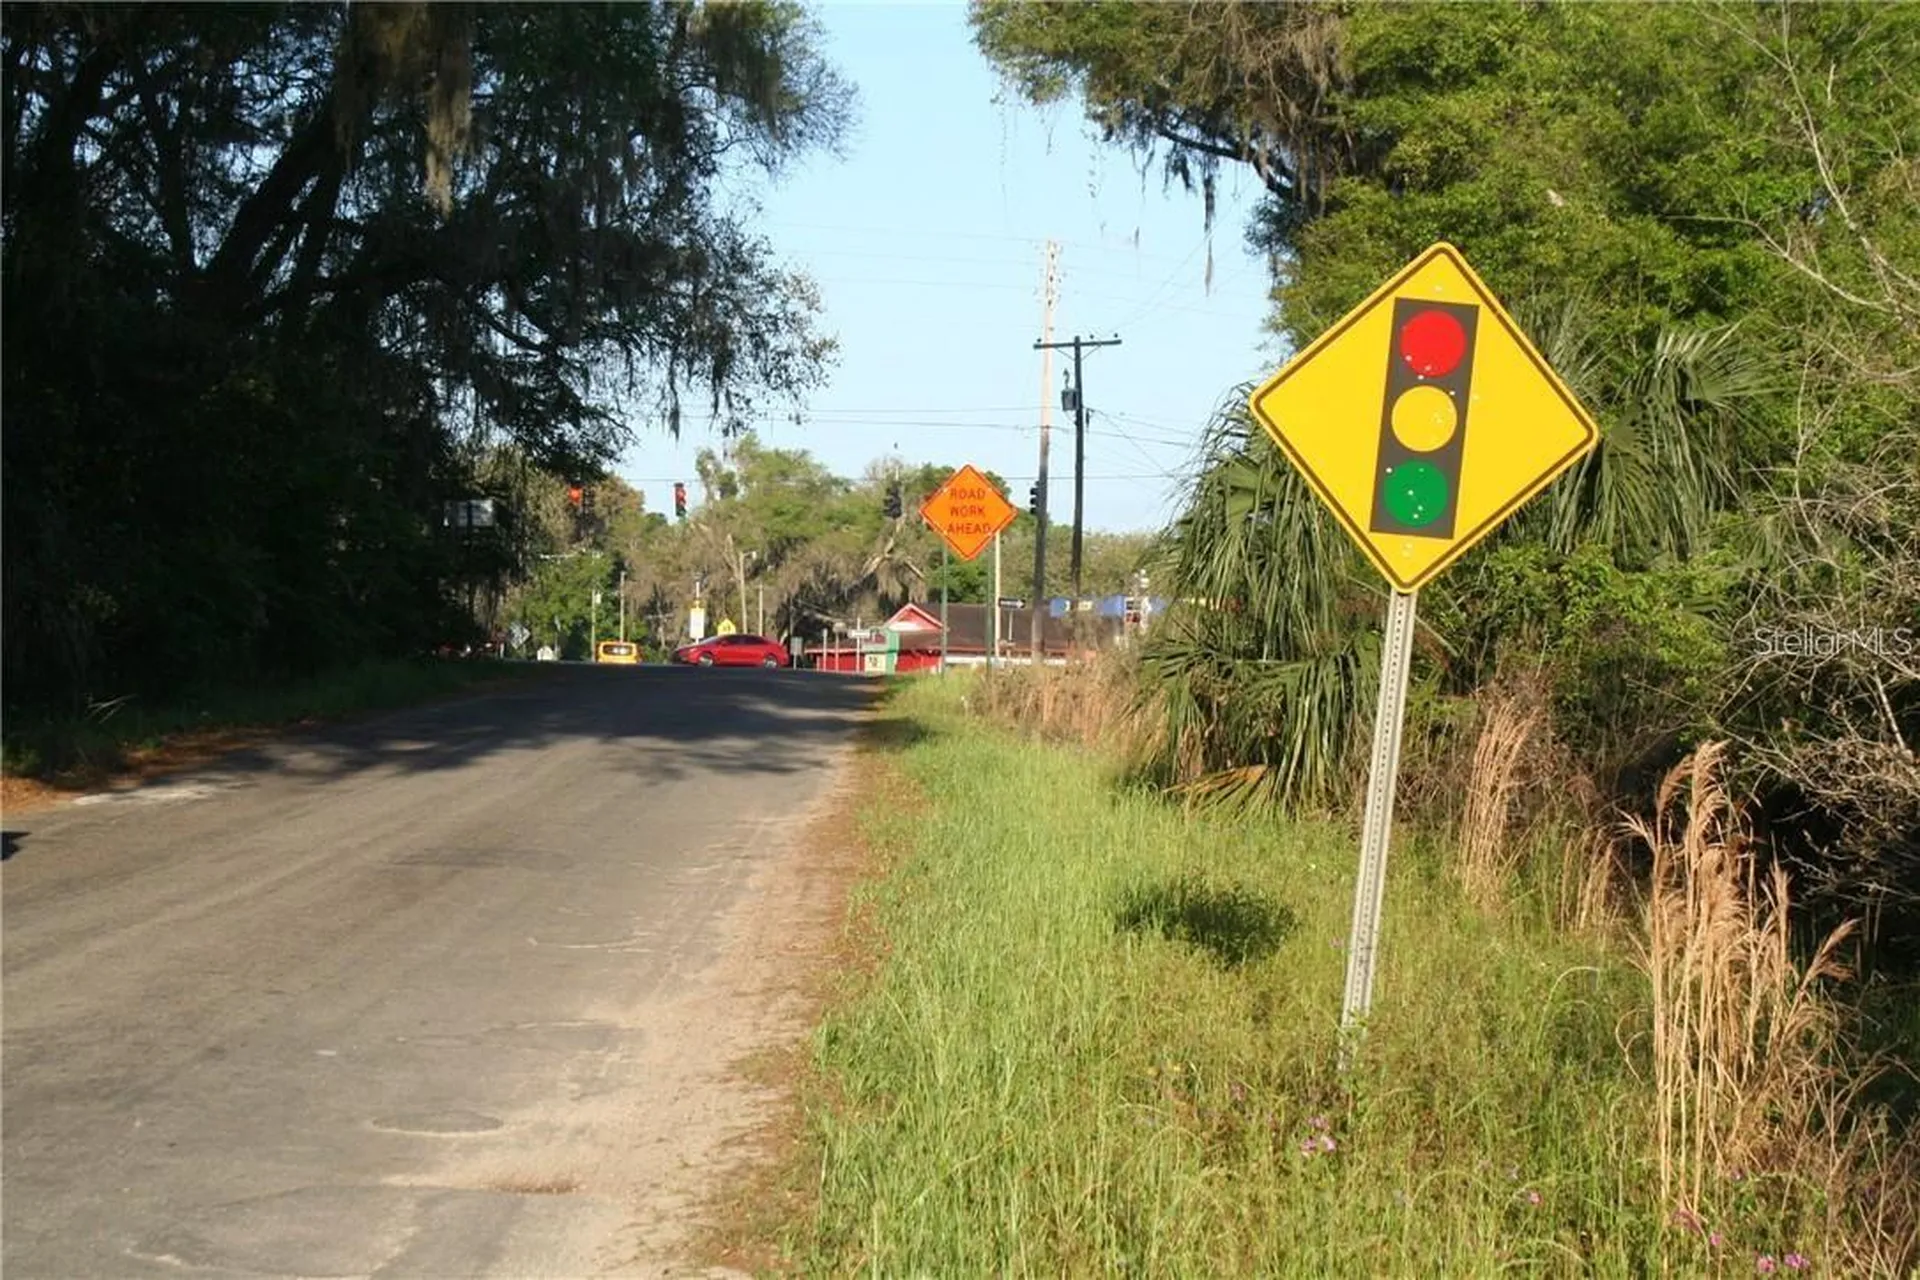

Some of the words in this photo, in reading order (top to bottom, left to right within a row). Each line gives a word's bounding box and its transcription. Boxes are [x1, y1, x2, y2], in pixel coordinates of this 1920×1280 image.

[950, 488, 985, 500] ROAD
[949, 505, 986, 517] WORK
[948, 523, 991, 535] AHEAD
